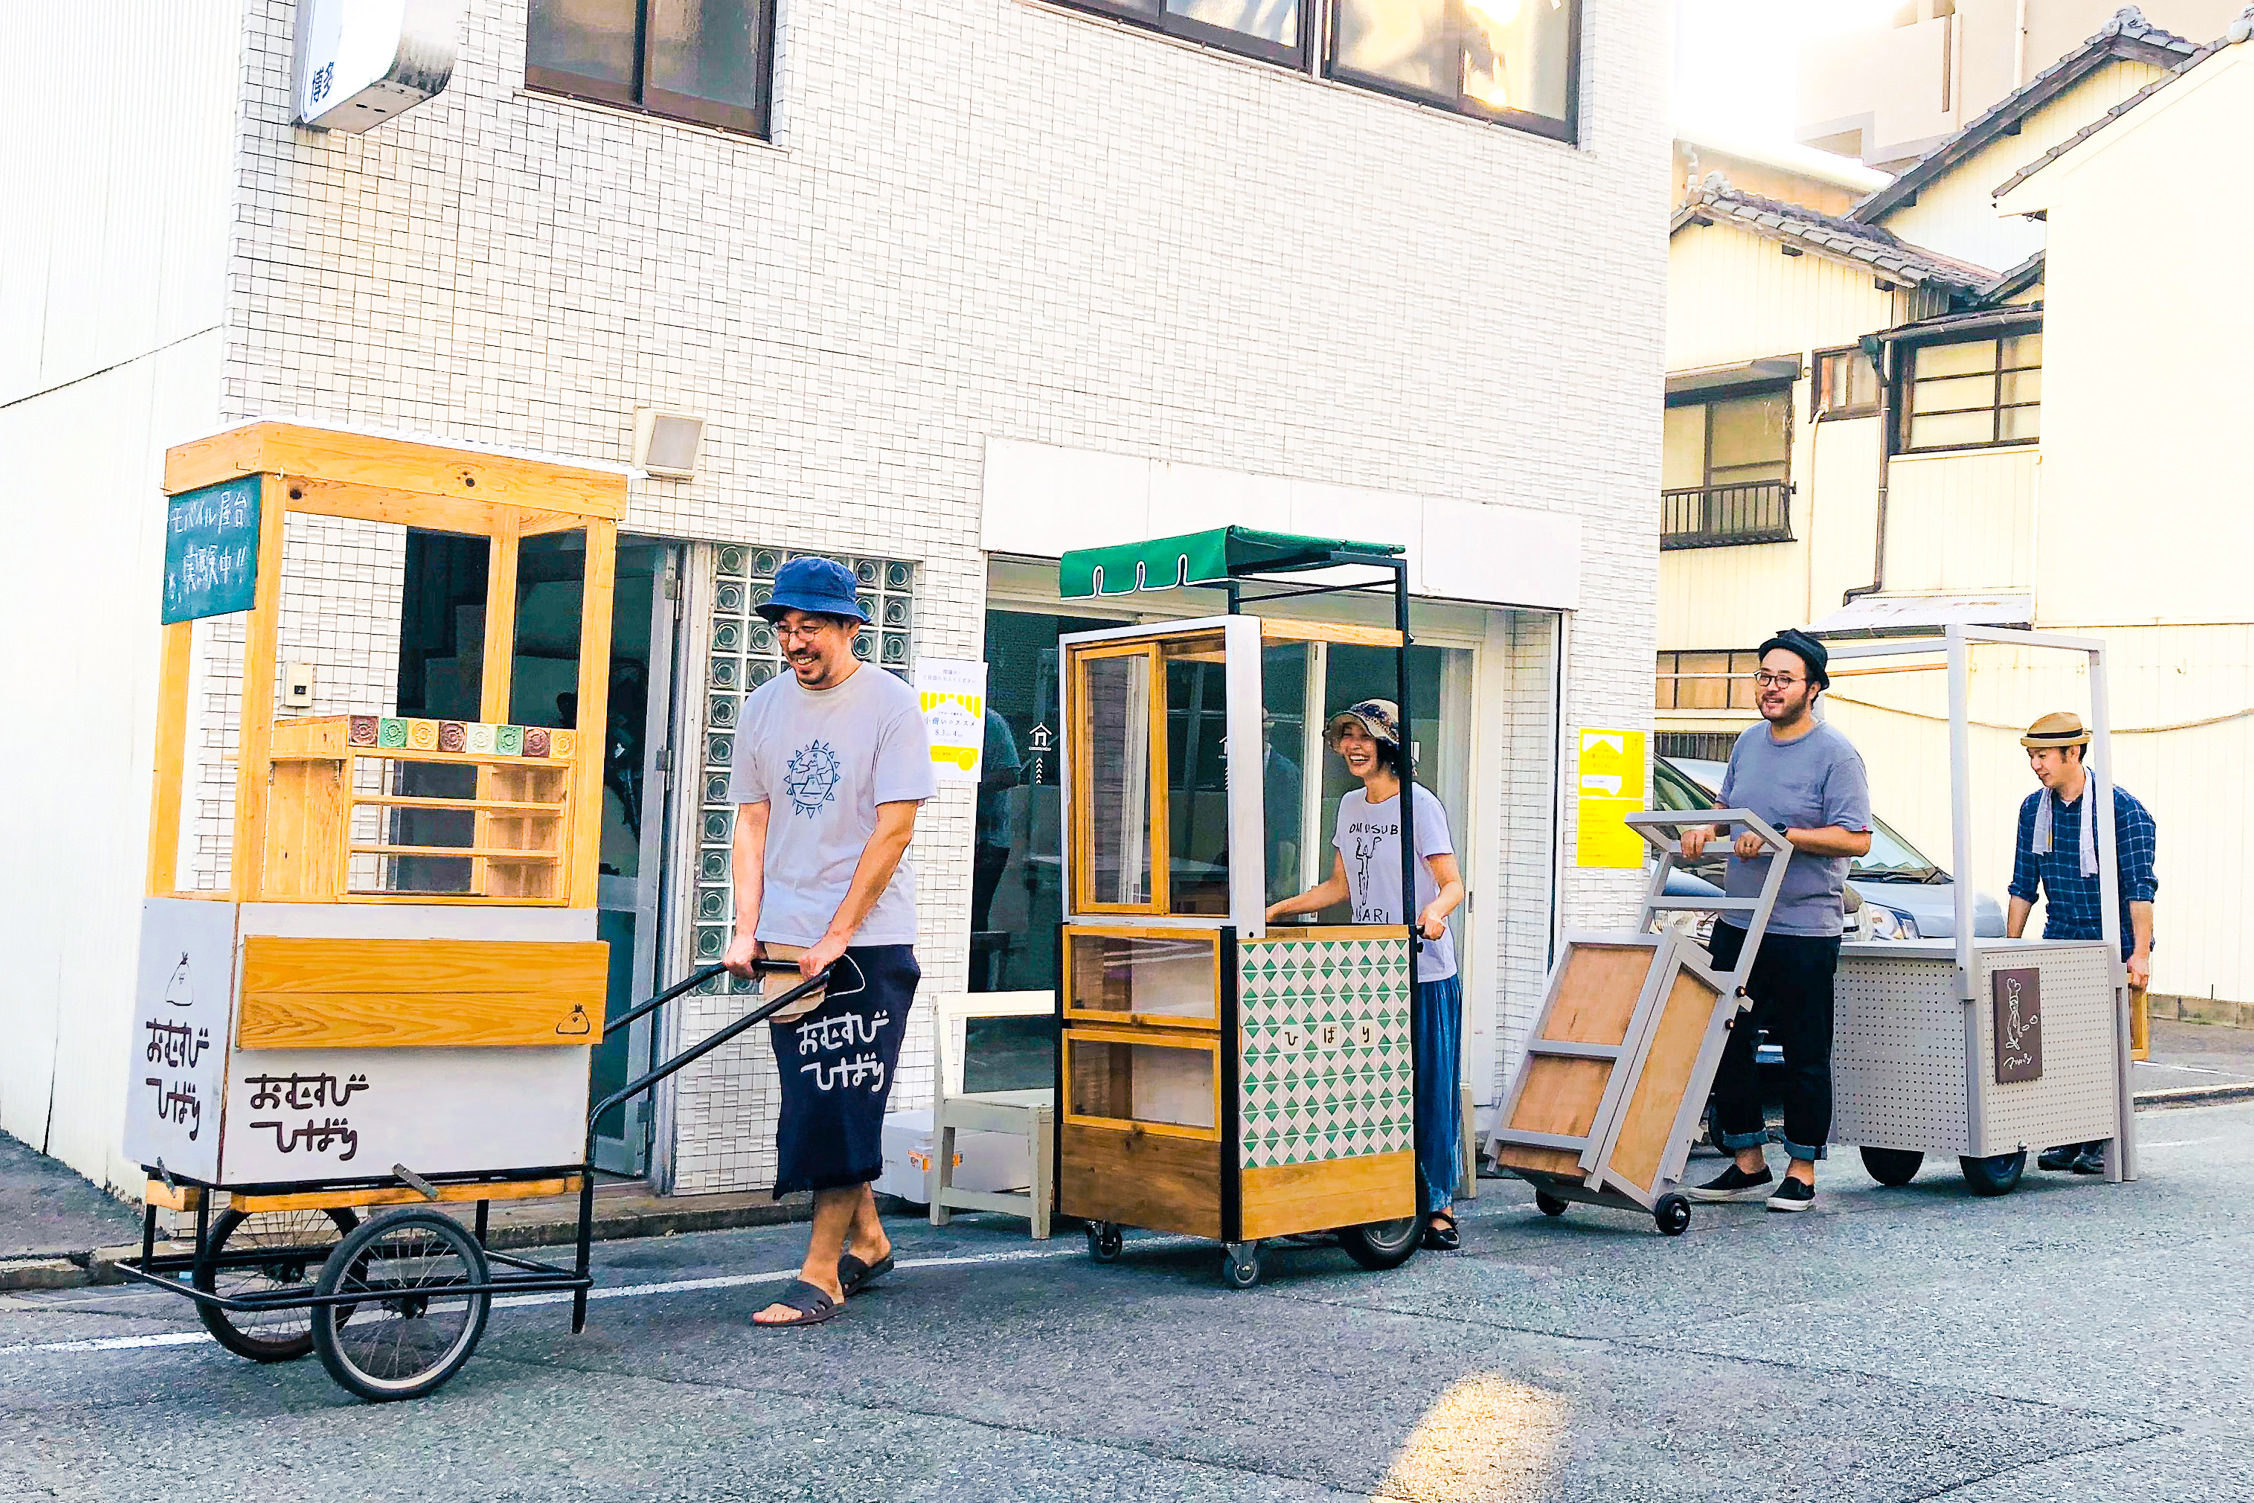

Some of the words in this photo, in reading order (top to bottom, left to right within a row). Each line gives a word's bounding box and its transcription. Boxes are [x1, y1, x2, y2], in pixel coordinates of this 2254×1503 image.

[171, 490, 247, 534] モバイル屋台
[1349, 823, 1399, 835] OMUSUB
[146, 1018, 209, 1068] おむすび
[796, 1009, 890, 1055] おむすび
[245, 1072, 369, 1110] おむすび
[800, 1052, 885, 1092] ひばり
[146, 1078, 200, 1141] ひばり
[250, 1118, 357, 1161] ひばり
